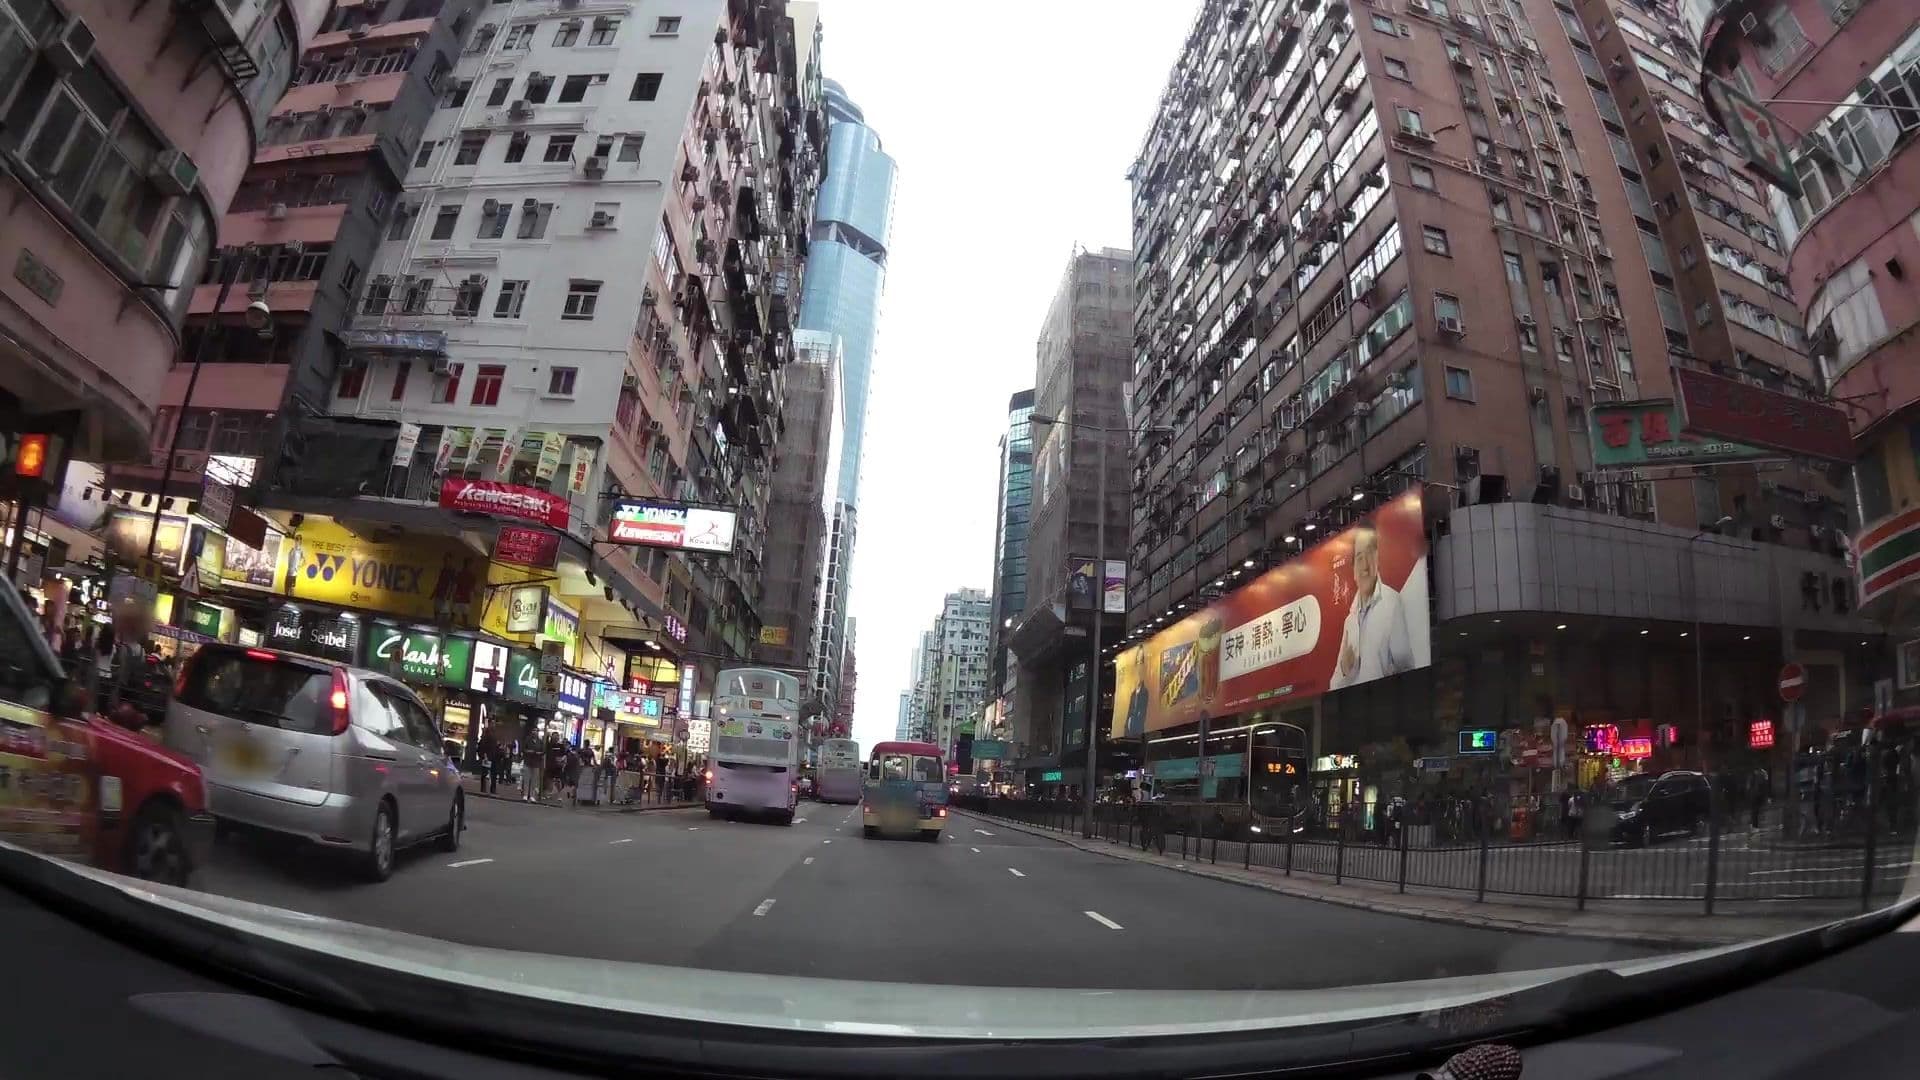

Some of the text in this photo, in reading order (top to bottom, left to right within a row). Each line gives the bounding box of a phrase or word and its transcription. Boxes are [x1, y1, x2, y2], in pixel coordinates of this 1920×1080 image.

[351, 558, 424, 593] YONEX
[274, 622, 347, 648] Josef Seibel
[1285, 763, 1296, 774] 2A
